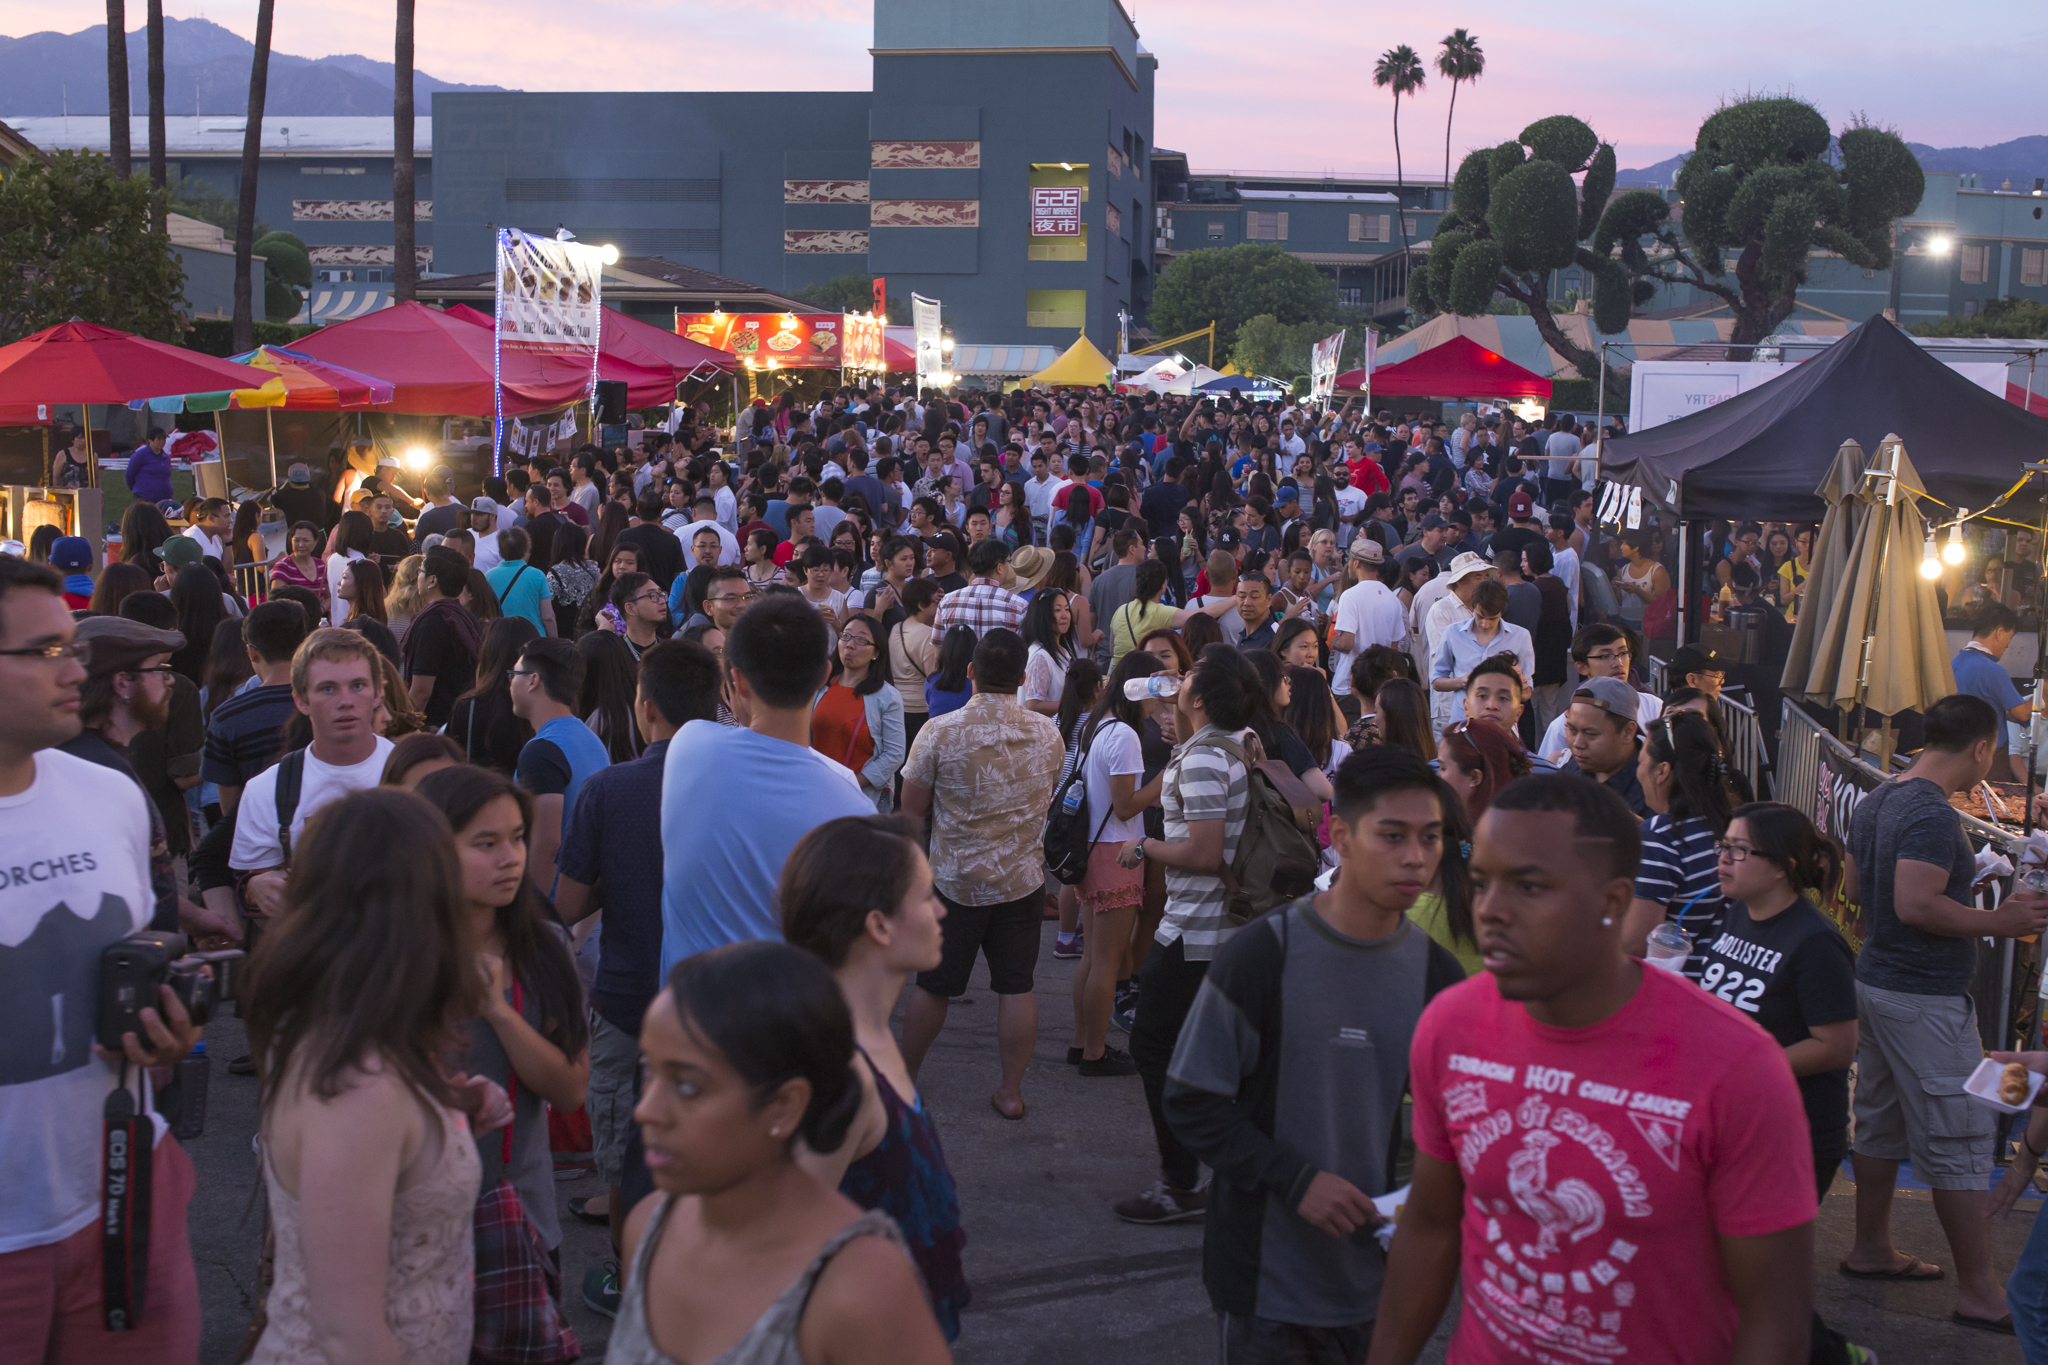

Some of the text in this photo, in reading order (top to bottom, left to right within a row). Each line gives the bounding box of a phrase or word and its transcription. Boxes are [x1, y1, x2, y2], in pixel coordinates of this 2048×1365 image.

[1035, 191, 1078, 206] 626
[1035, 207, 1077, 215] NIGHT MARKET
[1035, 219, 1077, 232] 夜市
[1711, 932, 1783, 974] HOLLISTER
[1699, 956, 1766, 1013] 922
[1524, 1064, 1575, 1095] HOT
[1578, 1080, 1630, 1106] CHILI
[1628, 1091, 1692, 1119] SAUCE
[109, 1129, 128, 1170] EOS
